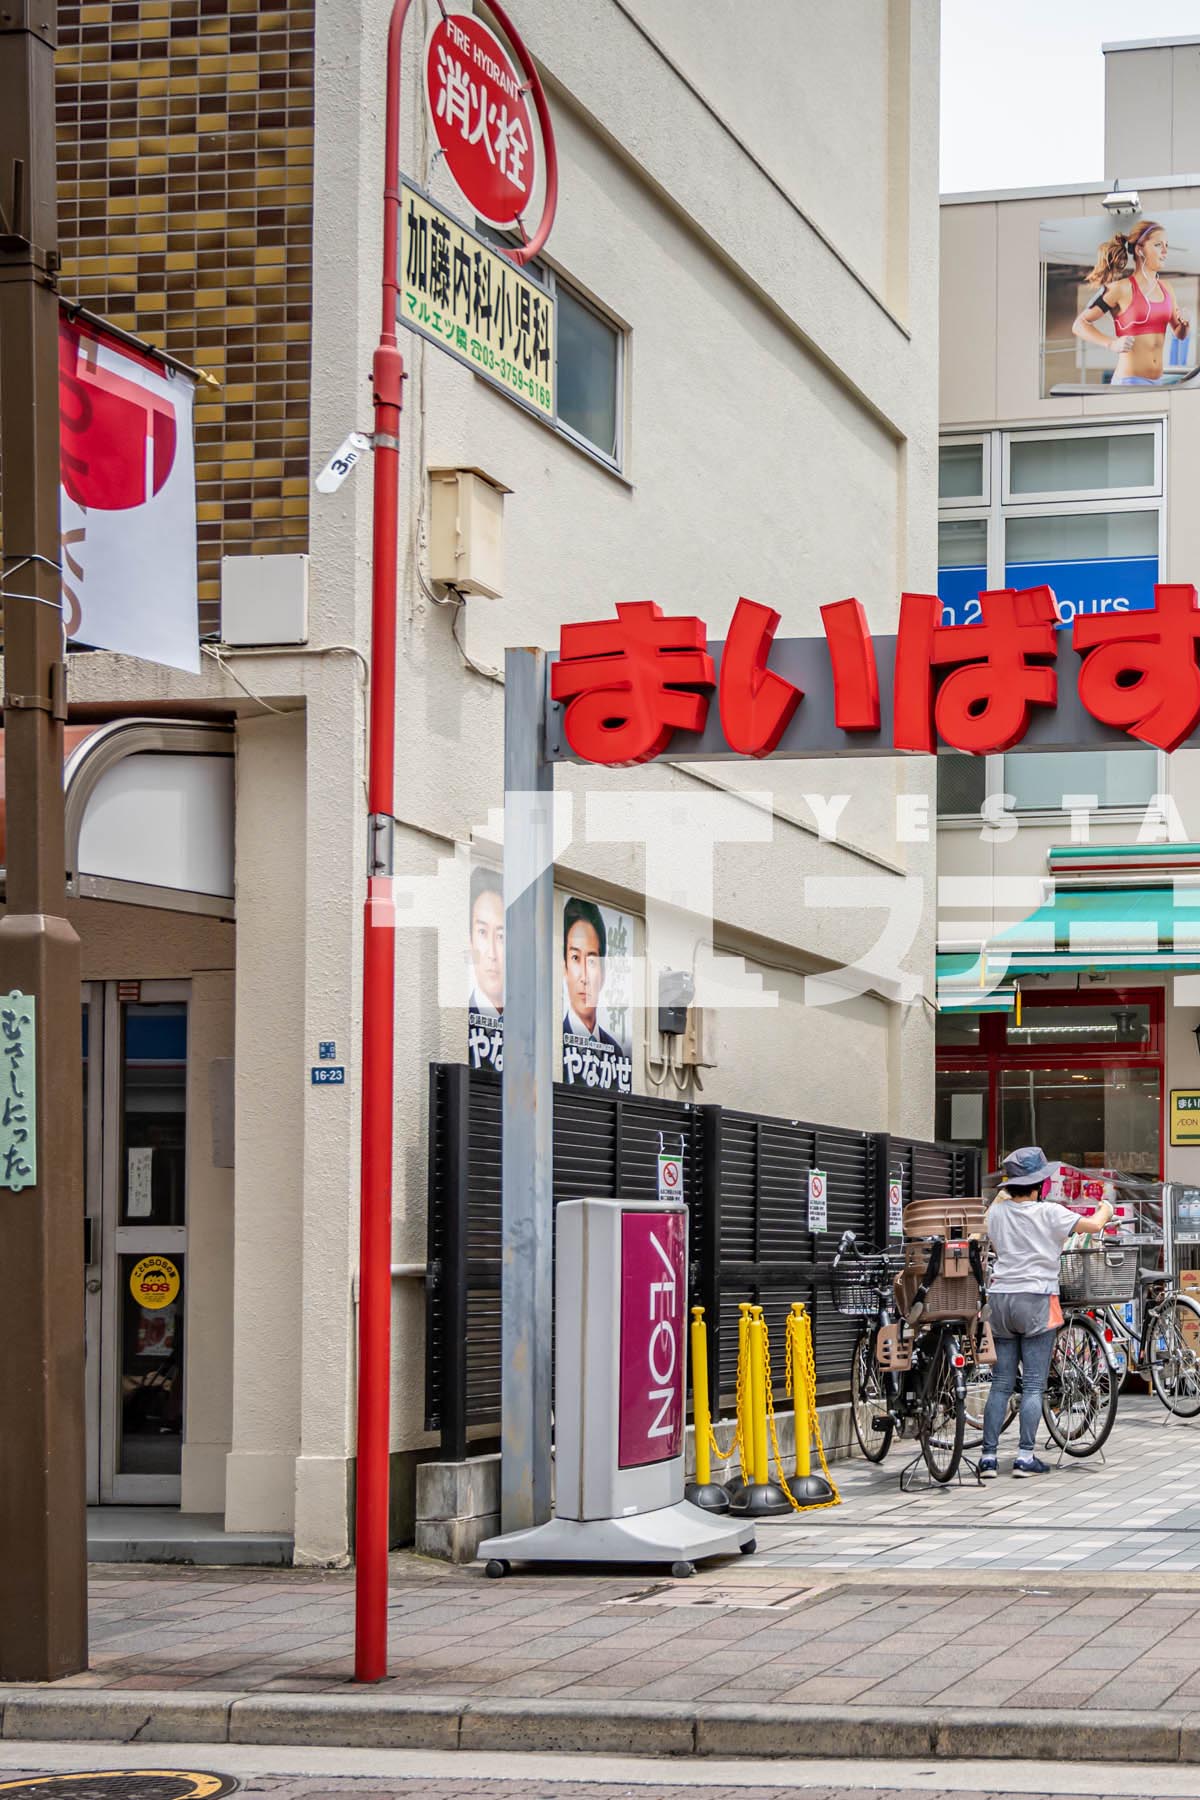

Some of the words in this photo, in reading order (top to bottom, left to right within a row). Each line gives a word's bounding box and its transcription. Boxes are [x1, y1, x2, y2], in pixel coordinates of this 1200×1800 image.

[446, 20, 470, 57] FIRE
[473, 43, 520, 102] HYDRANT
[436, 45, 528, 192] 消火栓
[406, 200, 551, 383] 加藤内科小児科
[331, 452, 358, 475] 3m
[2, 1009, 32, 1180] むさしにった
[315, 1071, 342, 1080] 16-23
[563, 1046, 632, 1090] やながせ
[140, 1283, 170, 1292] SOS
